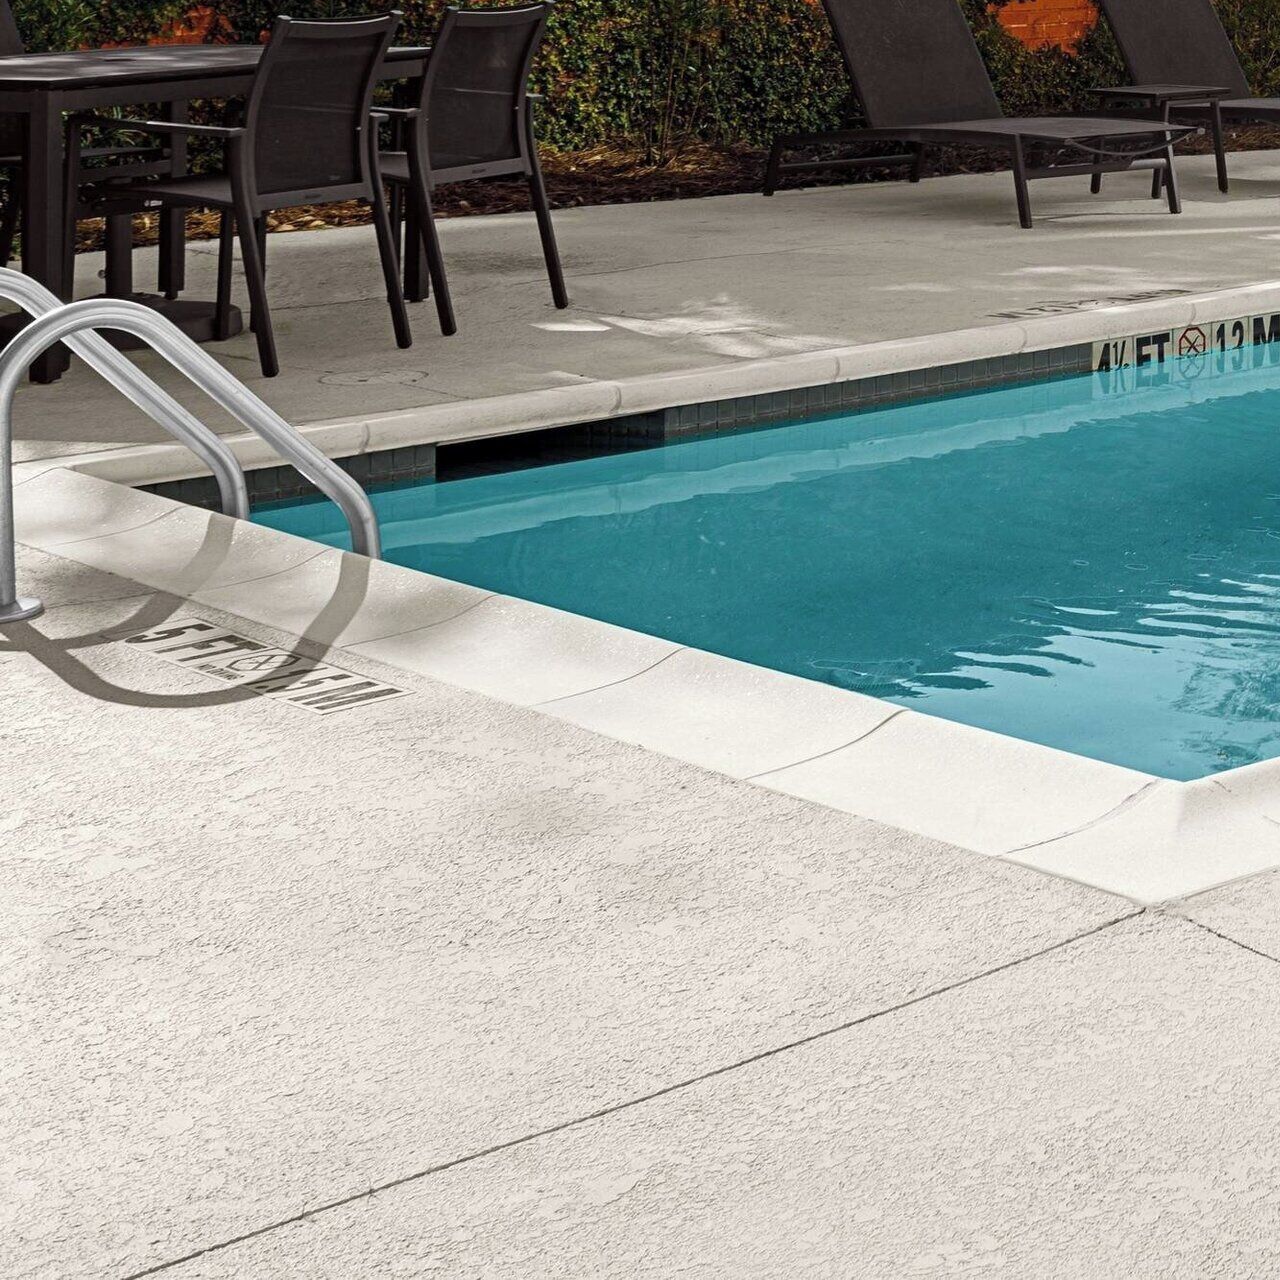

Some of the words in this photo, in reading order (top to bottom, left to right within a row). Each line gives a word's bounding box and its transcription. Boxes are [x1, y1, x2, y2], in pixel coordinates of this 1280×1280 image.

[124, 623, 216, 645] 5
[154, 634, 269, 662] FT
[287, 681, 405, 711] M
